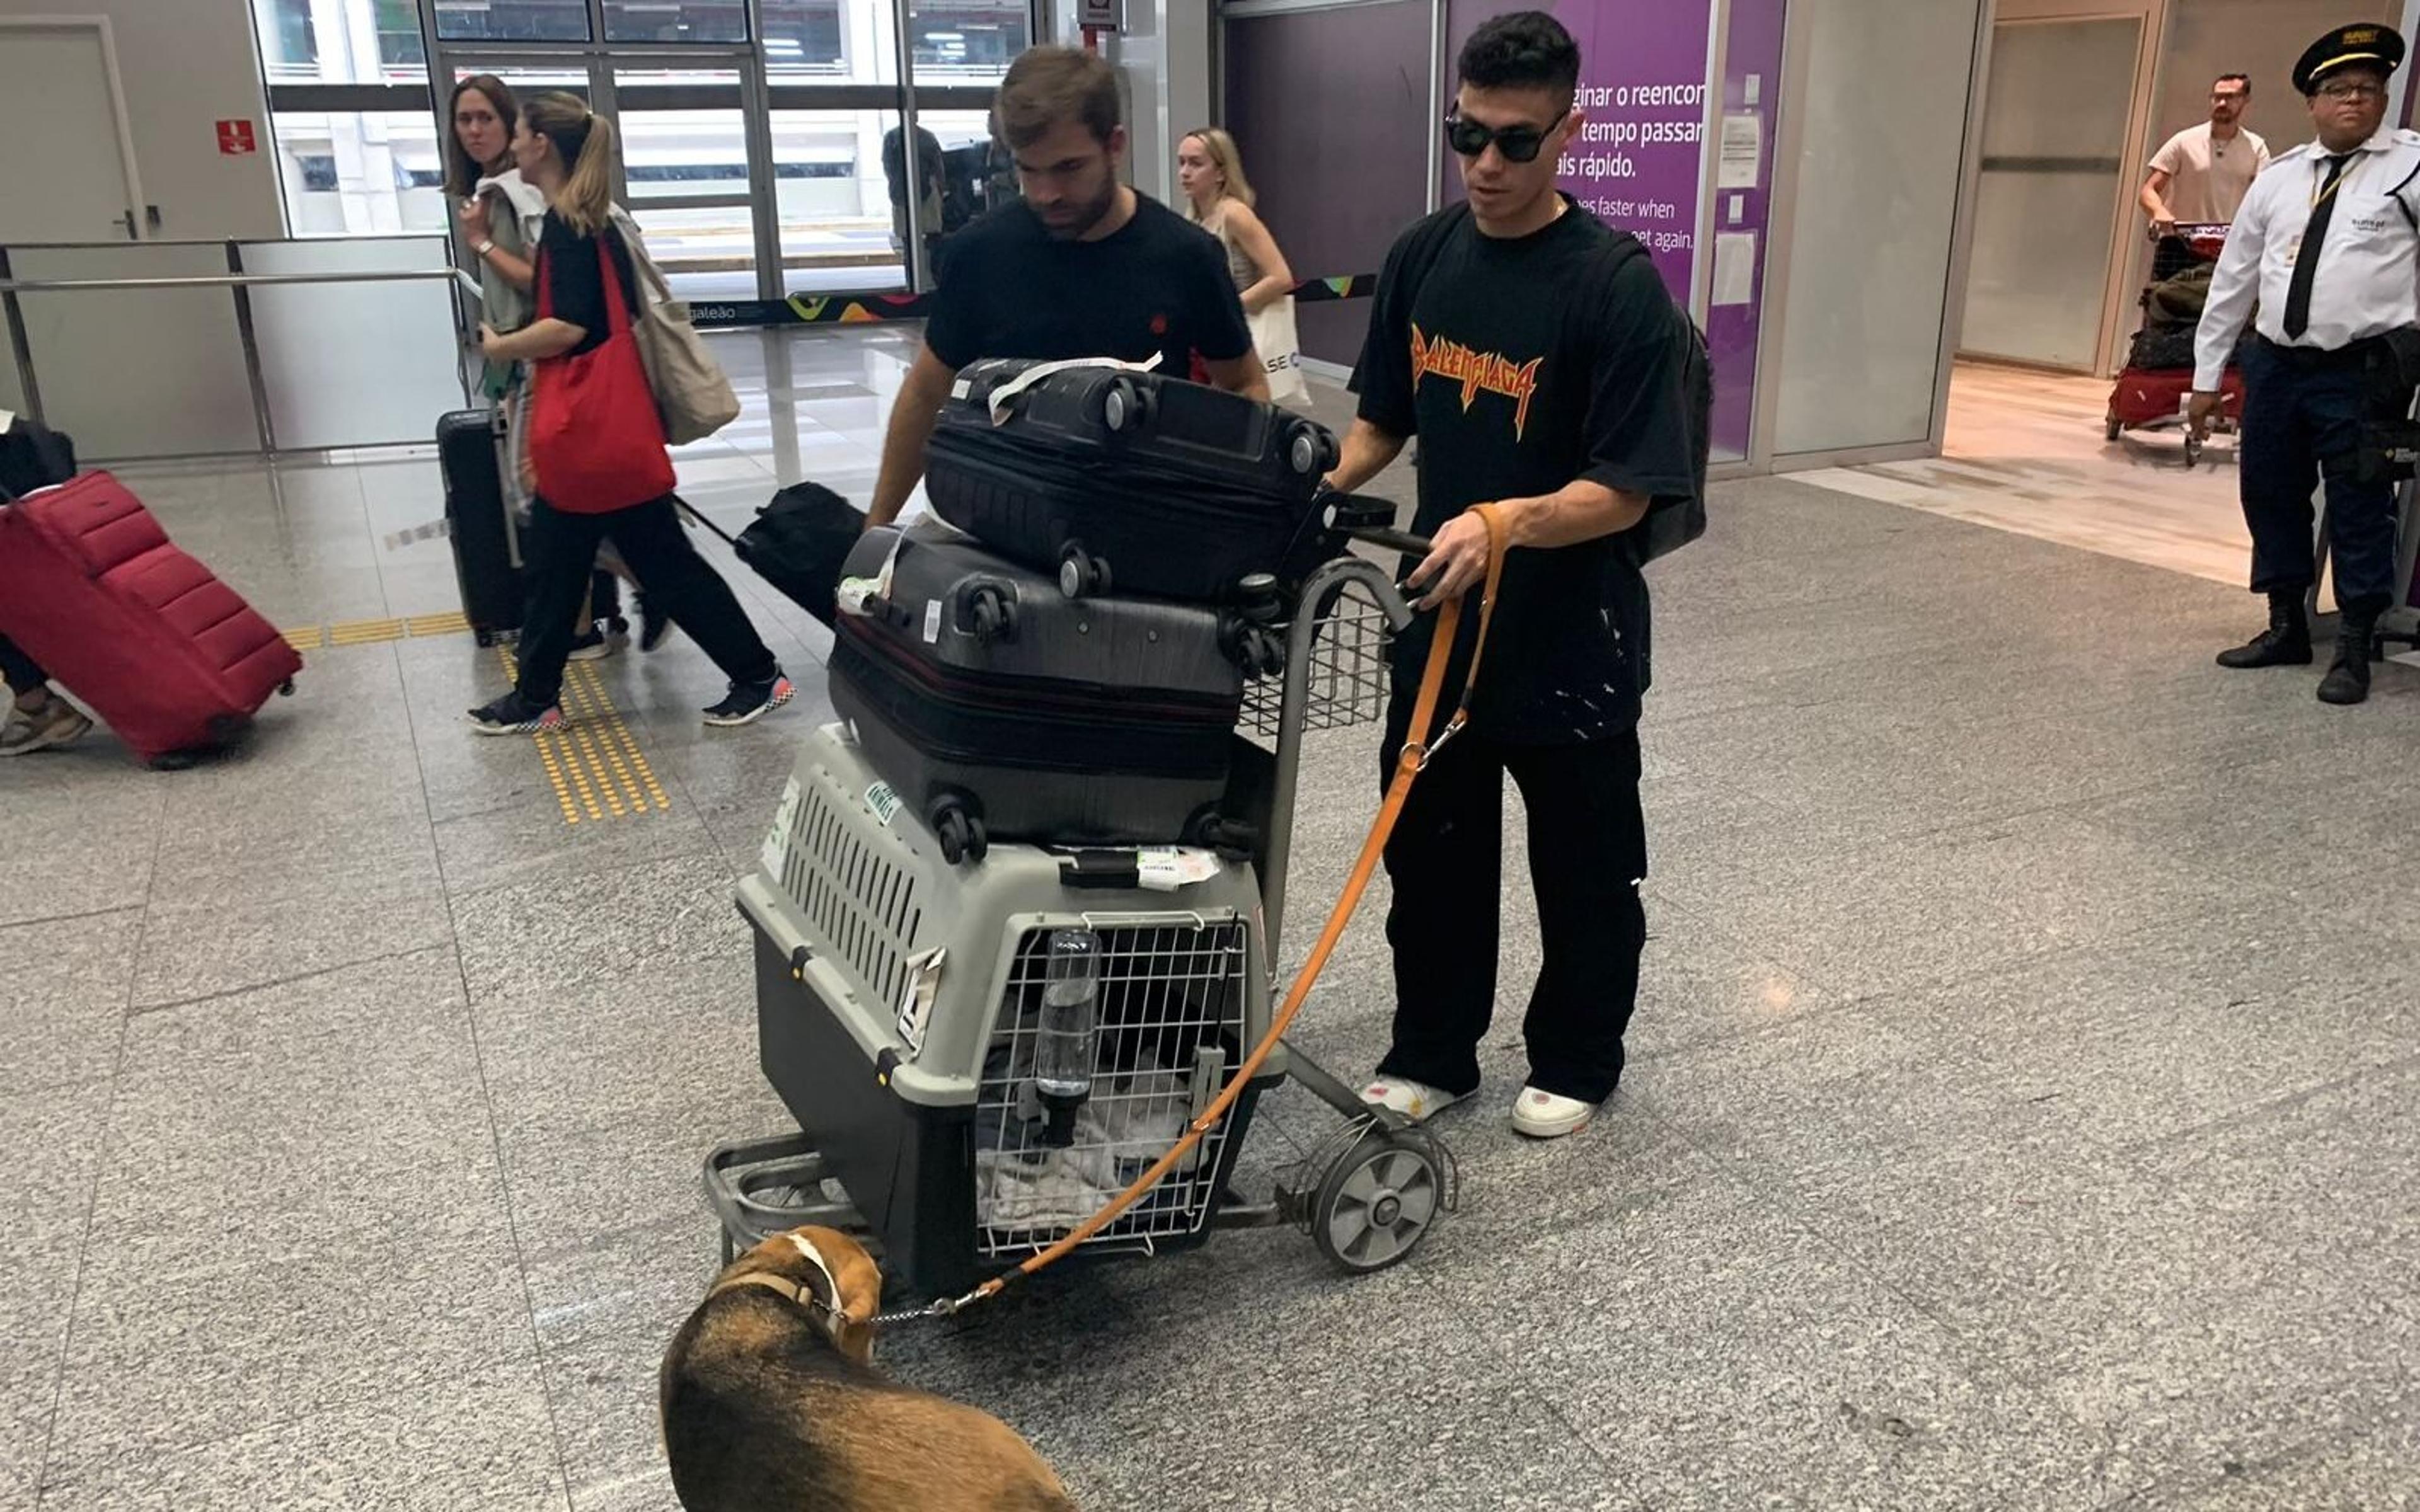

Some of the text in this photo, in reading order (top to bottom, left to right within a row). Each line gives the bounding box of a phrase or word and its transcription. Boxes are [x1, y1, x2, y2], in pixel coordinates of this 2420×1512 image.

[1616, 87, 1628, 106] o
[1582, 120, 1637, 148] tempo
[1641, 122, 1703, 147] passar
[1579, 151, 1636, 182] rápido.
[1598, 196, 1635, 216] faster
[1639, 198, 1676, 219] when
[1655, 229, 1694, 252] again.
